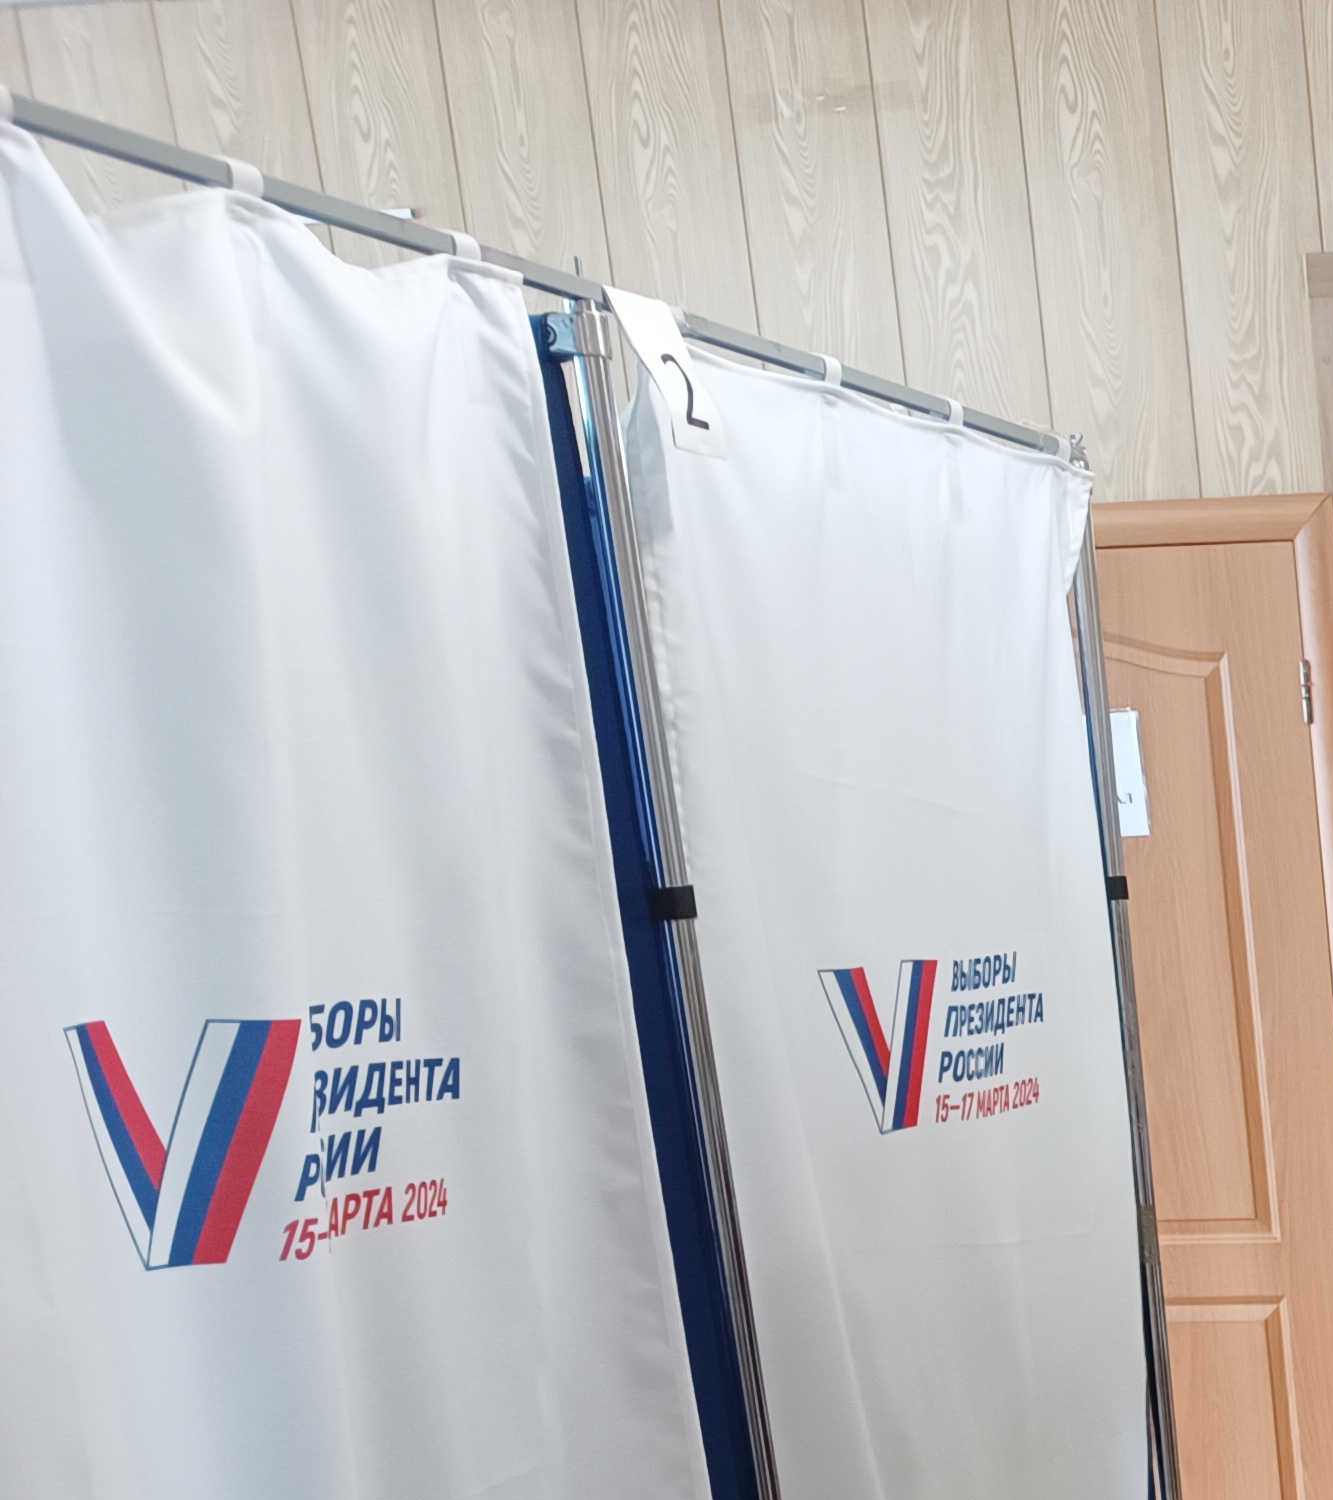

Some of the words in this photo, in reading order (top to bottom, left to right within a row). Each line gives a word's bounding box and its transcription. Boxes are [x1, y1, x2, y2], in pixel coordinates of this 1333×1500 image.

[951, 951, 1017, 992] ВЫБОРЫ
[943, 992, 1044, 1037] ПРЕЗИДЕНТА
[938, 1042, 1005, 1083] РОССИИ
[976, 1083, 1010, 1119] МАРТА
[1012, 1076, 1040, 1109] 2024
[401, 1178, 448, 1222] 2024
